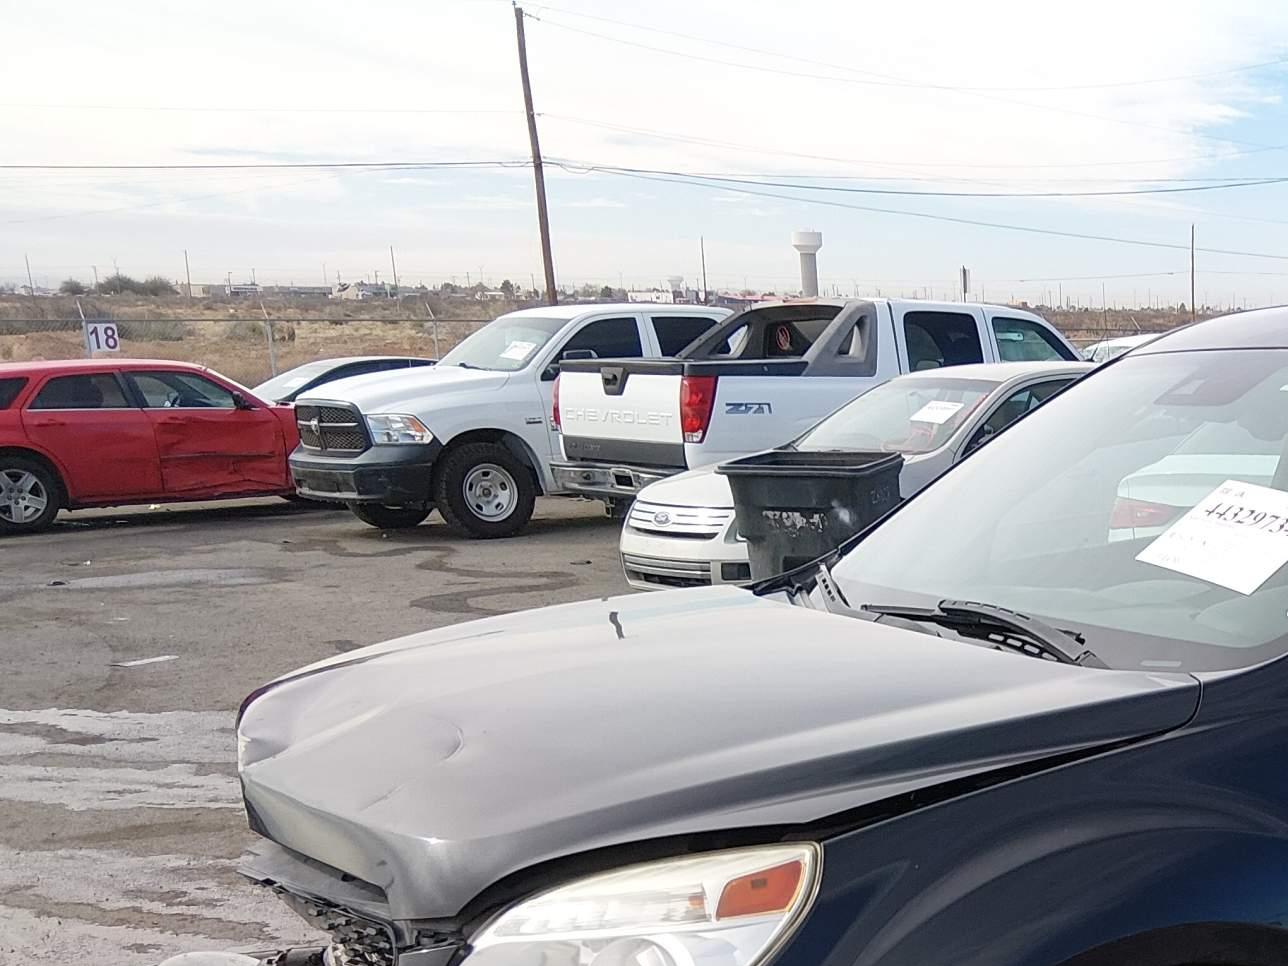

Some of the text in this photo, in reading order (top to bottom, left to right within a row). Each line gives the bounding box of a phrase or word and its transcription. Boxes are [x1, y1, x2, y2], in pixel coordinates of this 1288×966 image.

[89, 326, 118, 350] 18
[565, 407, 673, 426] CHEVROLET
[725, 402, 773, 415] Z71
